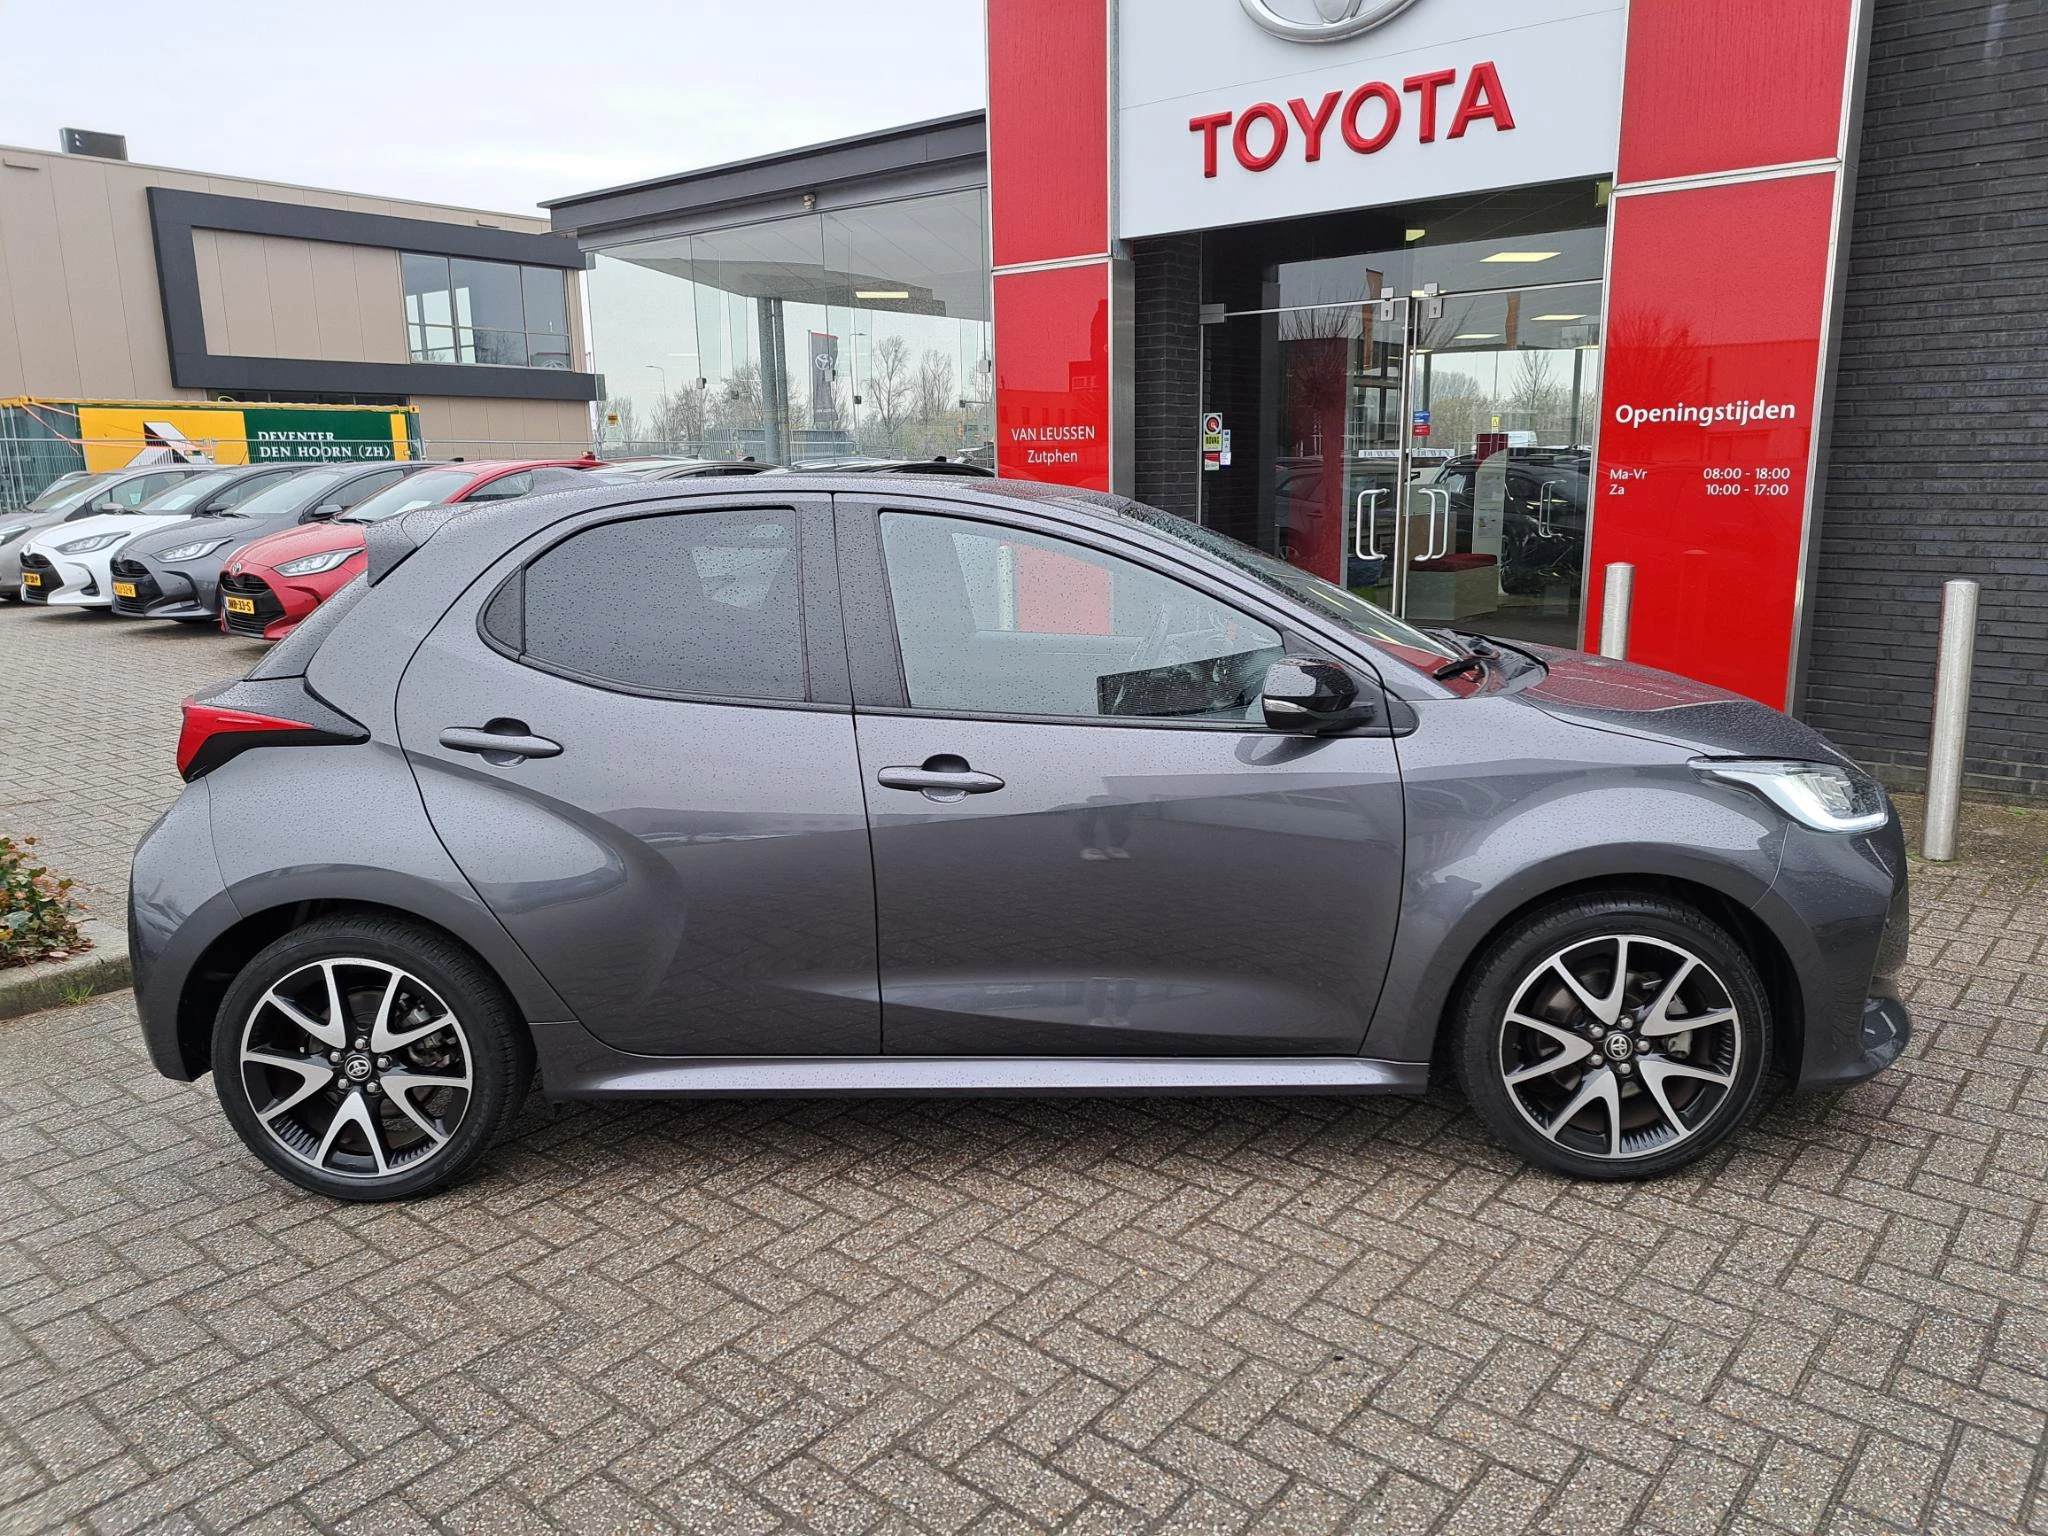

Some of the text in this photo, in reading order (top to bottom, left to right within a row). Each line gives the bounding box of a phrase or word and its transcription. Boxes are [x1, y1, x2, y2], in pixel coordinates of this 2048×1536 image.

[1189, 61, 1515, 178] TOYOTA
[1615, 399, 1796, 429] Openingstijden
[257, 431, 335, 442] DEVENTER
[1011, 425, 1095, 441] VAN LEUSSEN
[260, 444, 390, 459] DEN HOORN (ZH)
[1027, 448, 1078, 466] Zutphen
[1609, 468, 1648, 480] Ma-Vr
[1703, 468, 1742, 480] 08:00
[1755, 467, 1791, 480] 18:00
[1609, 484, 1625, 495] Za
[1706, 484, 1741, 496] 10:00
[1754, 483, 1789, 496] 17:00
